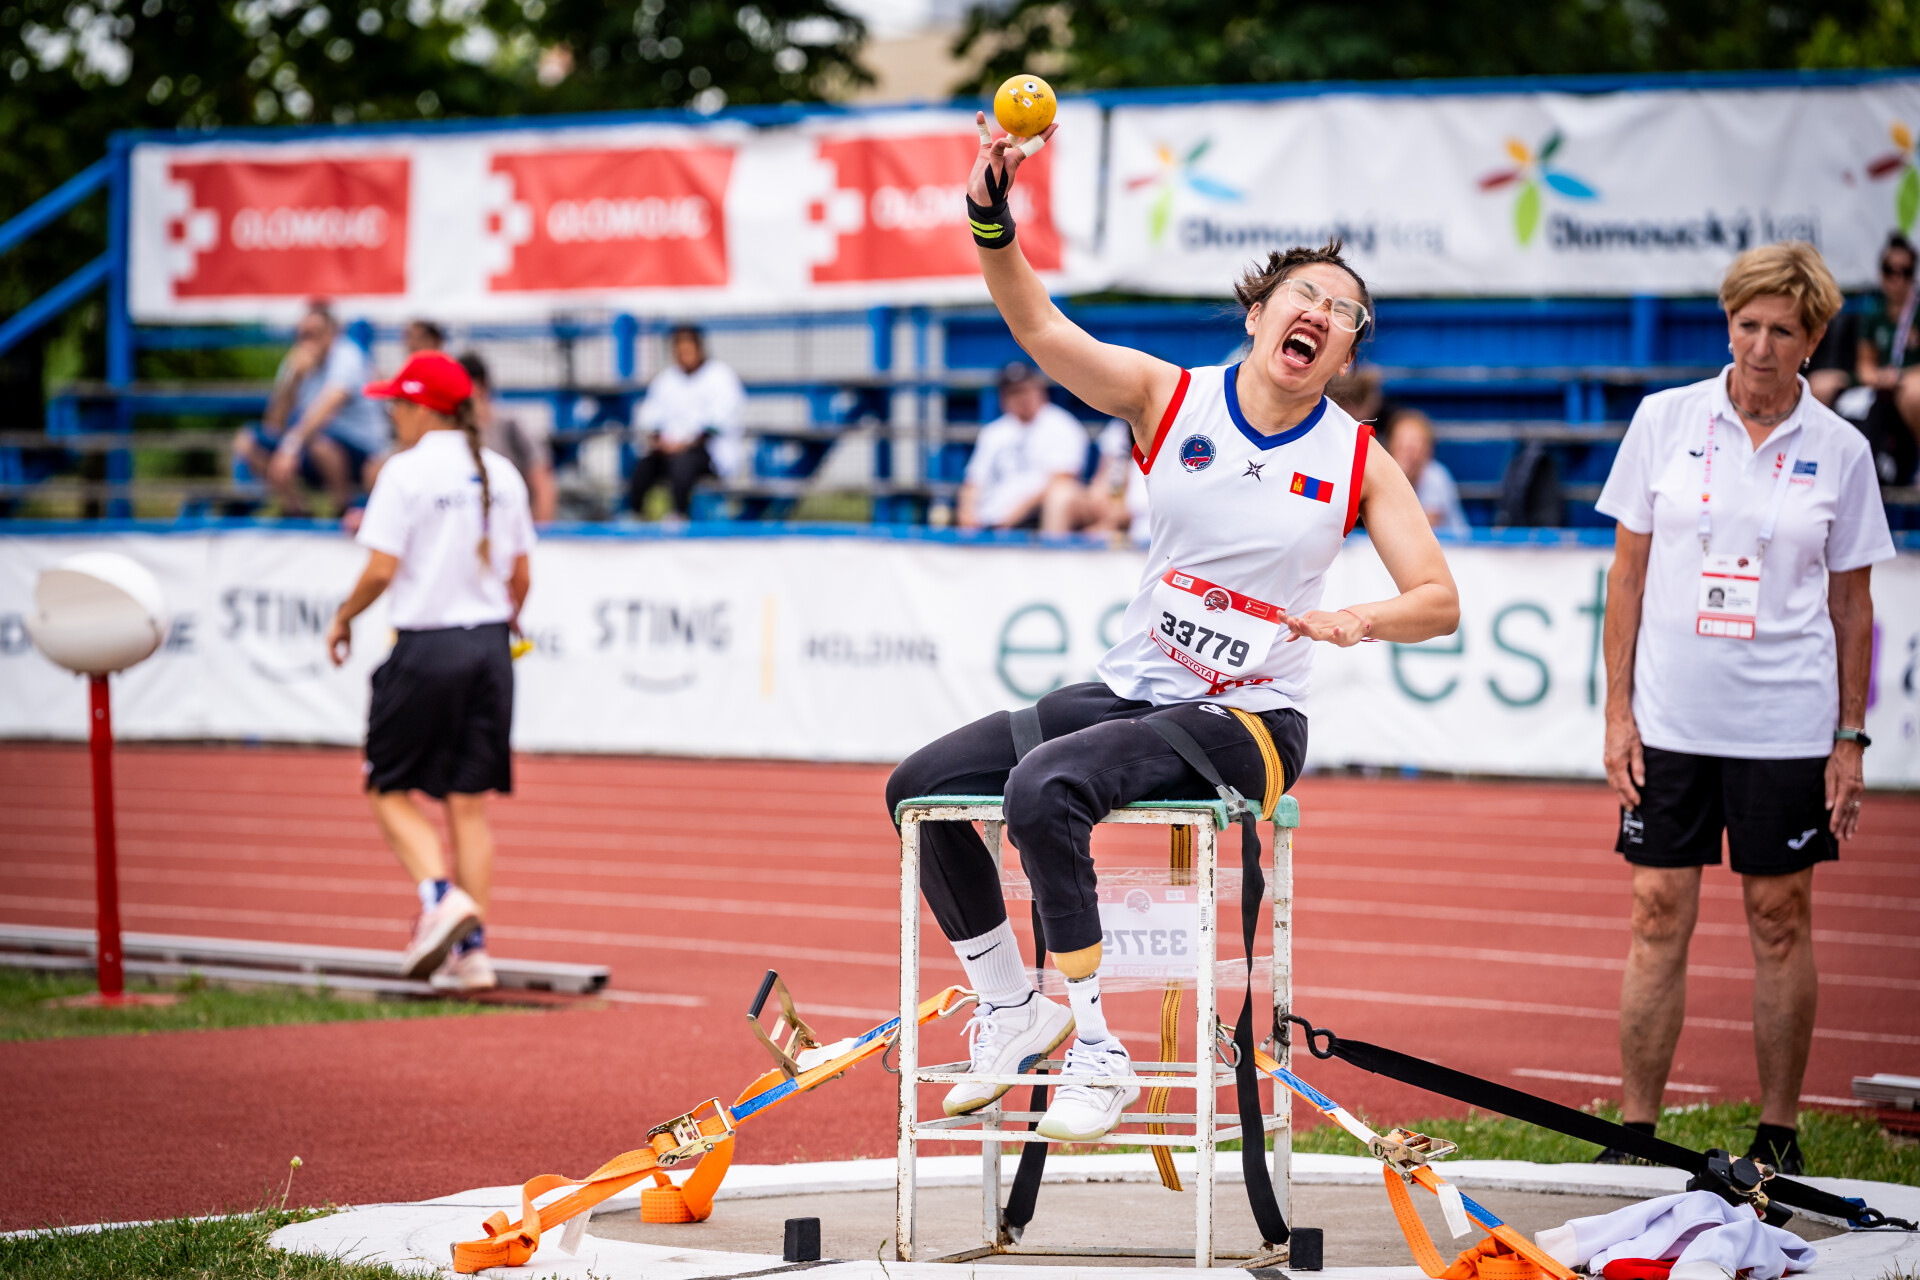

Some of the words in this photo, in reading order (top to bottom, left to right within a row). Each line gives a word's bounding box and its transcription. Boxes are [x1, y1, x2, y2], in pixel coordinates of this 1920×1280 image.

[231, 206, 389, 250] OLOMOUC
[547, 197, 711, 243] OLOMOUC
[220, 588, 338, 639] STIN
[593, 600, 731, 651] STING
[1160, 611, 1250, 668] 33779
[1176, 651, 1213, 680] TOYOTA
